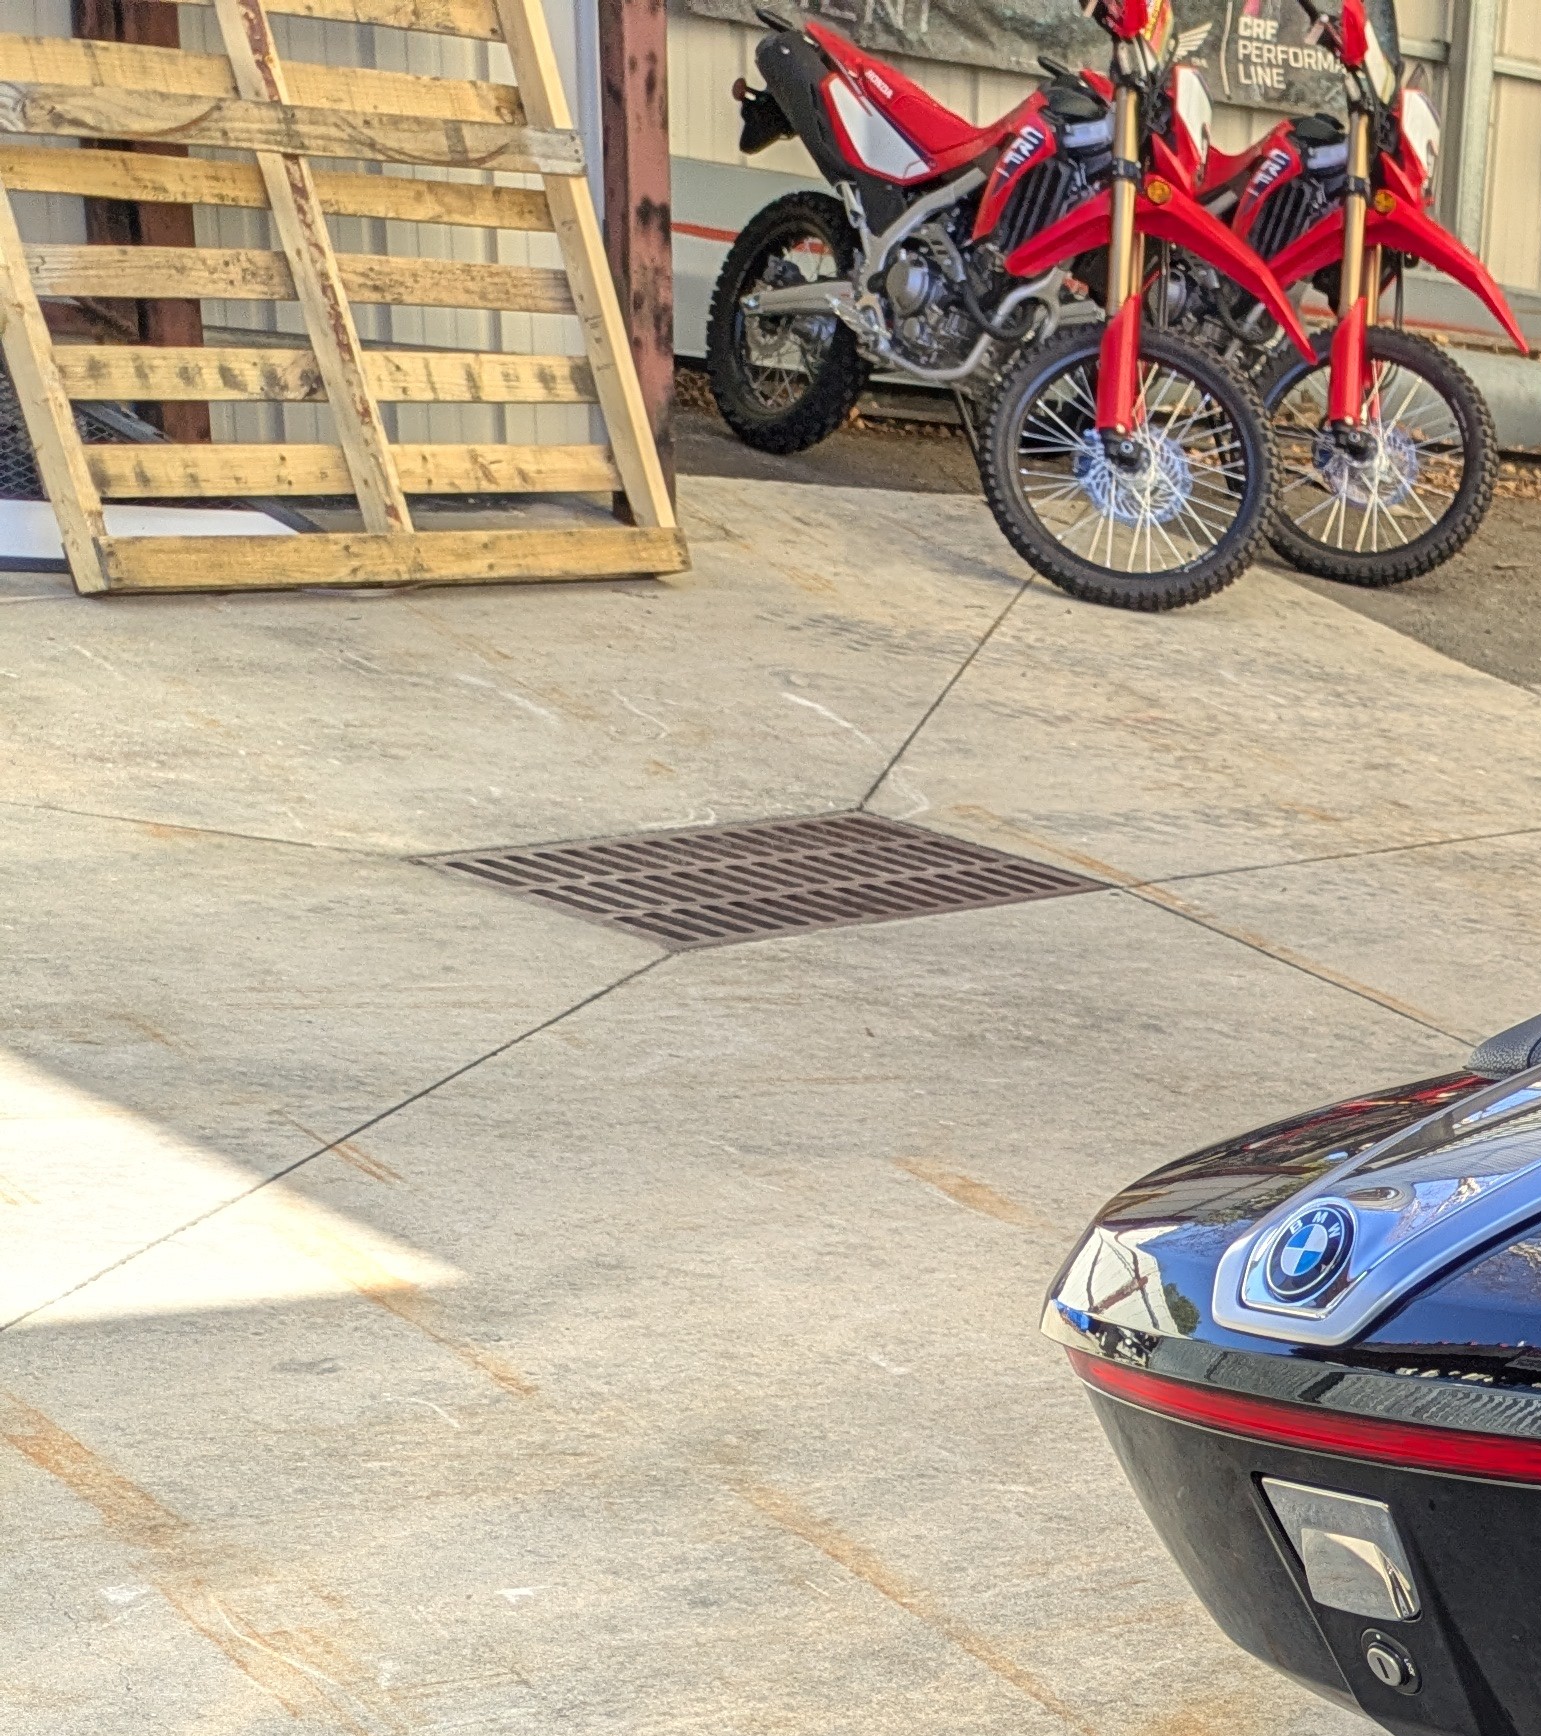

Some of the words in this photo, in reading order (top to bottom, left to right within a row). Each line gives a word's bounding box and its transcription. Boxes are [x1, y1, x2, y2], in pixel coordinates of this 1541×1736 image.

[1238, 16, 1279, 41] CRF
[1238, 63, 1287, 90] LINE
[1289, 1211, 1341, 1238] BMW
